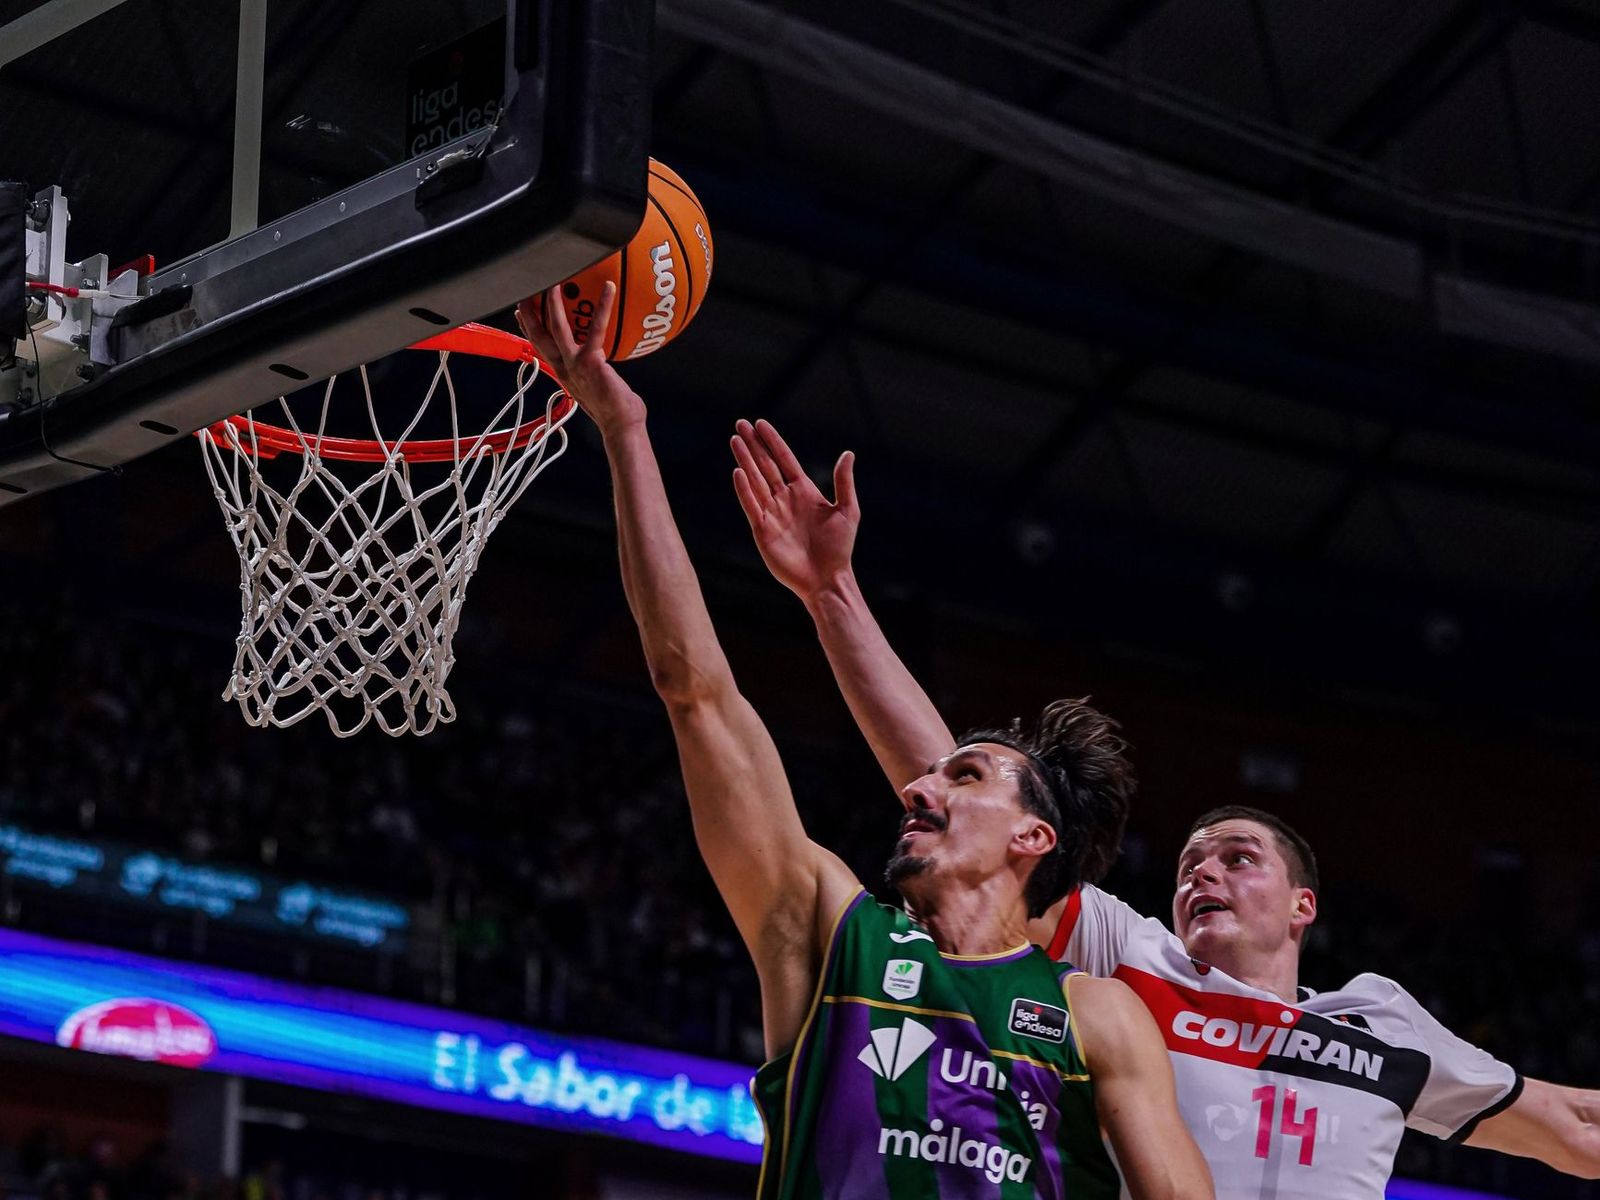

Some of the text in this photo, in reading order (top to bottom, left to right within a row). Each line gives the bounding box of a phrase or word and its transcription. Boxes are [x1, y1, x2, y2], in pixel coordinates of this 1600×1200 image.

[411, 81, 459, 125] liga
[411, 98, 505, 158] endes
[1013, 1020, 1062, 1038] endesa
[1016, 1008, 1039, 1022] liga
[434, 1031, 478, 1093] El
[490, 1042, 641, 1122] Sabor
[653, 1074, 713, 1136] de
[1252, 1085, 1319, 1167] 14
